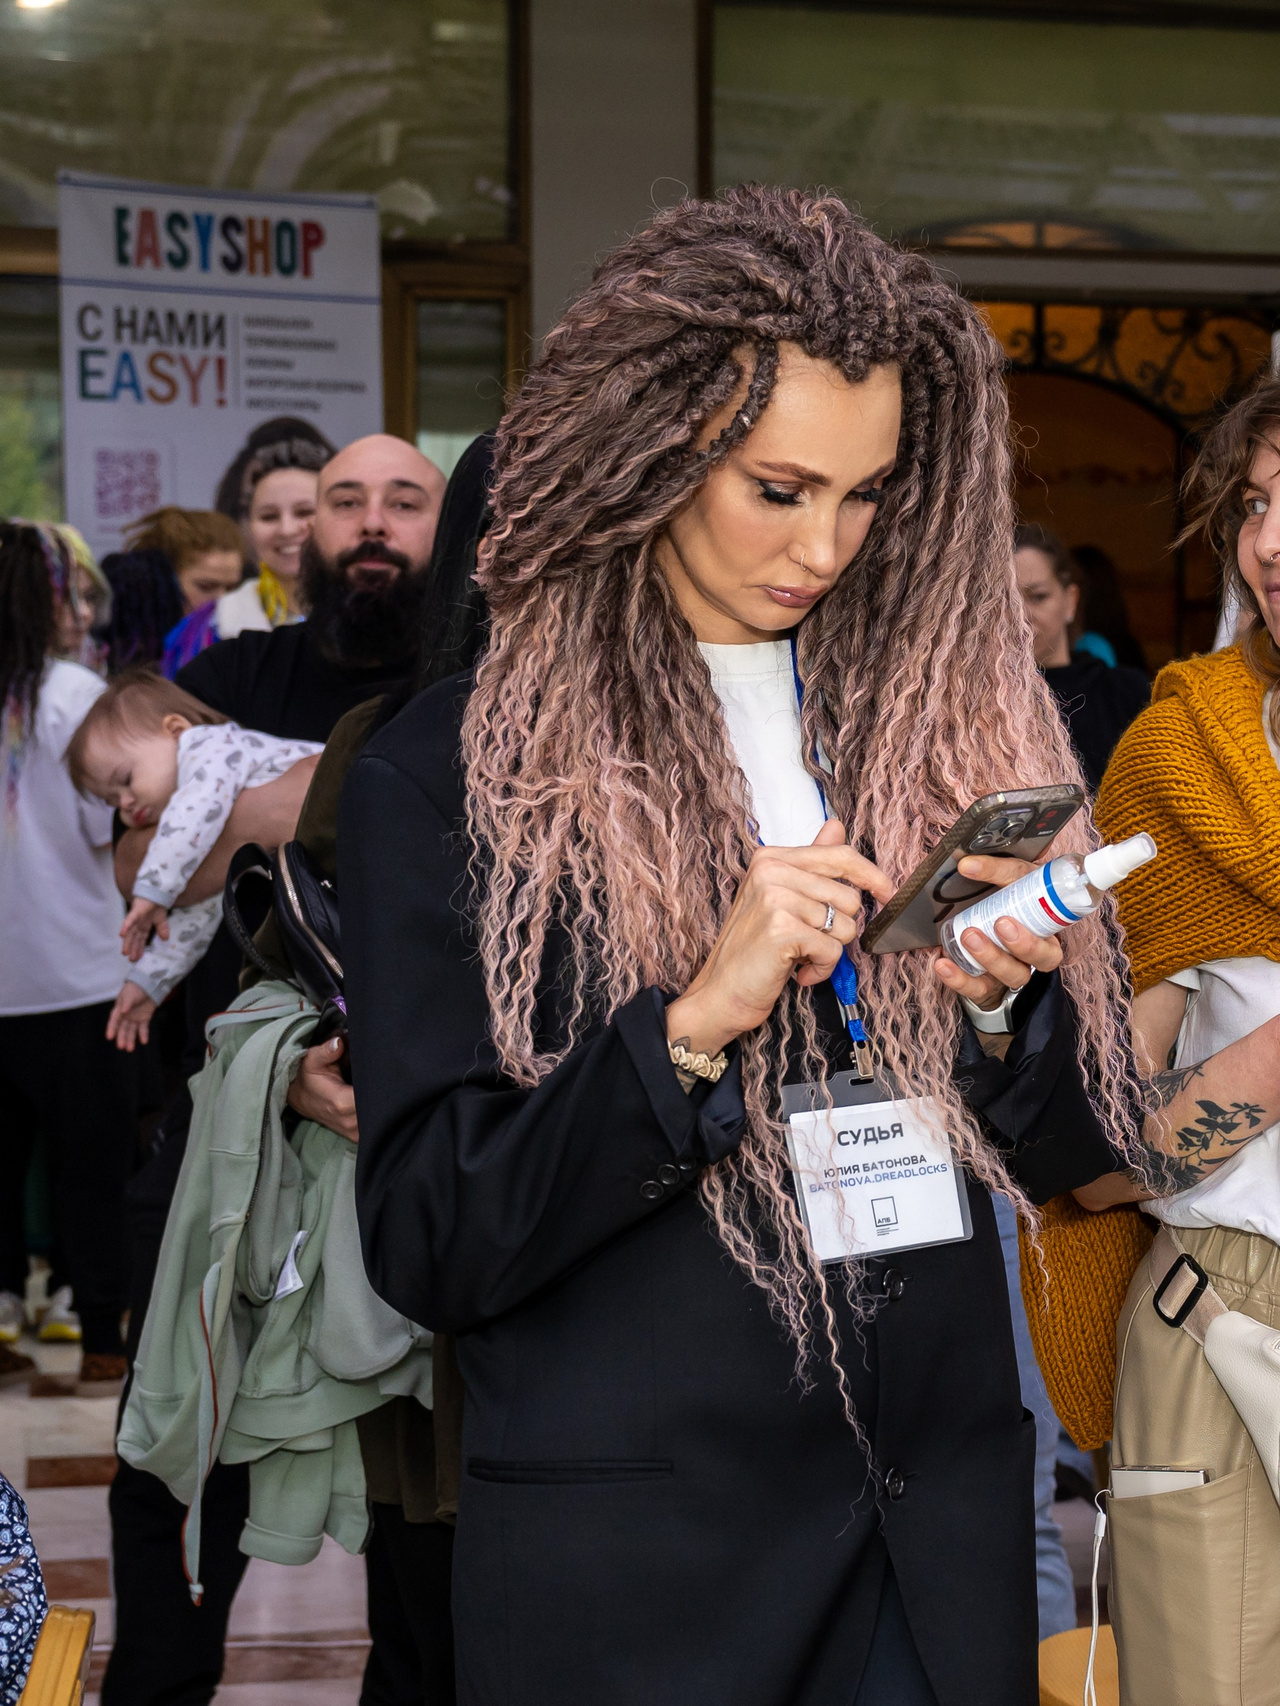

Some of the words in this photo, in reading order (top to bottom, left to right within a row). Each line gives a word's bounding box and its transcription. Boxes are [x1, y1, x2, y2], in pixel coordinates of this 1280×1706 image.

[114, 206, 325, 279] EASYSHOP
[77, 304, 102, 341] С
[113, 305, 227, 349] НАМИ
[77, 349, 227, 409] EASY!
[837, 1122, 904, 1147] СУДЬЯ
[809, 1163, 948, 1193] BATONOVA.DREADLOCKS
[823, 1164, 860, 1179] ЮЛИЯ
[862, 1154, 927, 1173] БАТОНОВА
